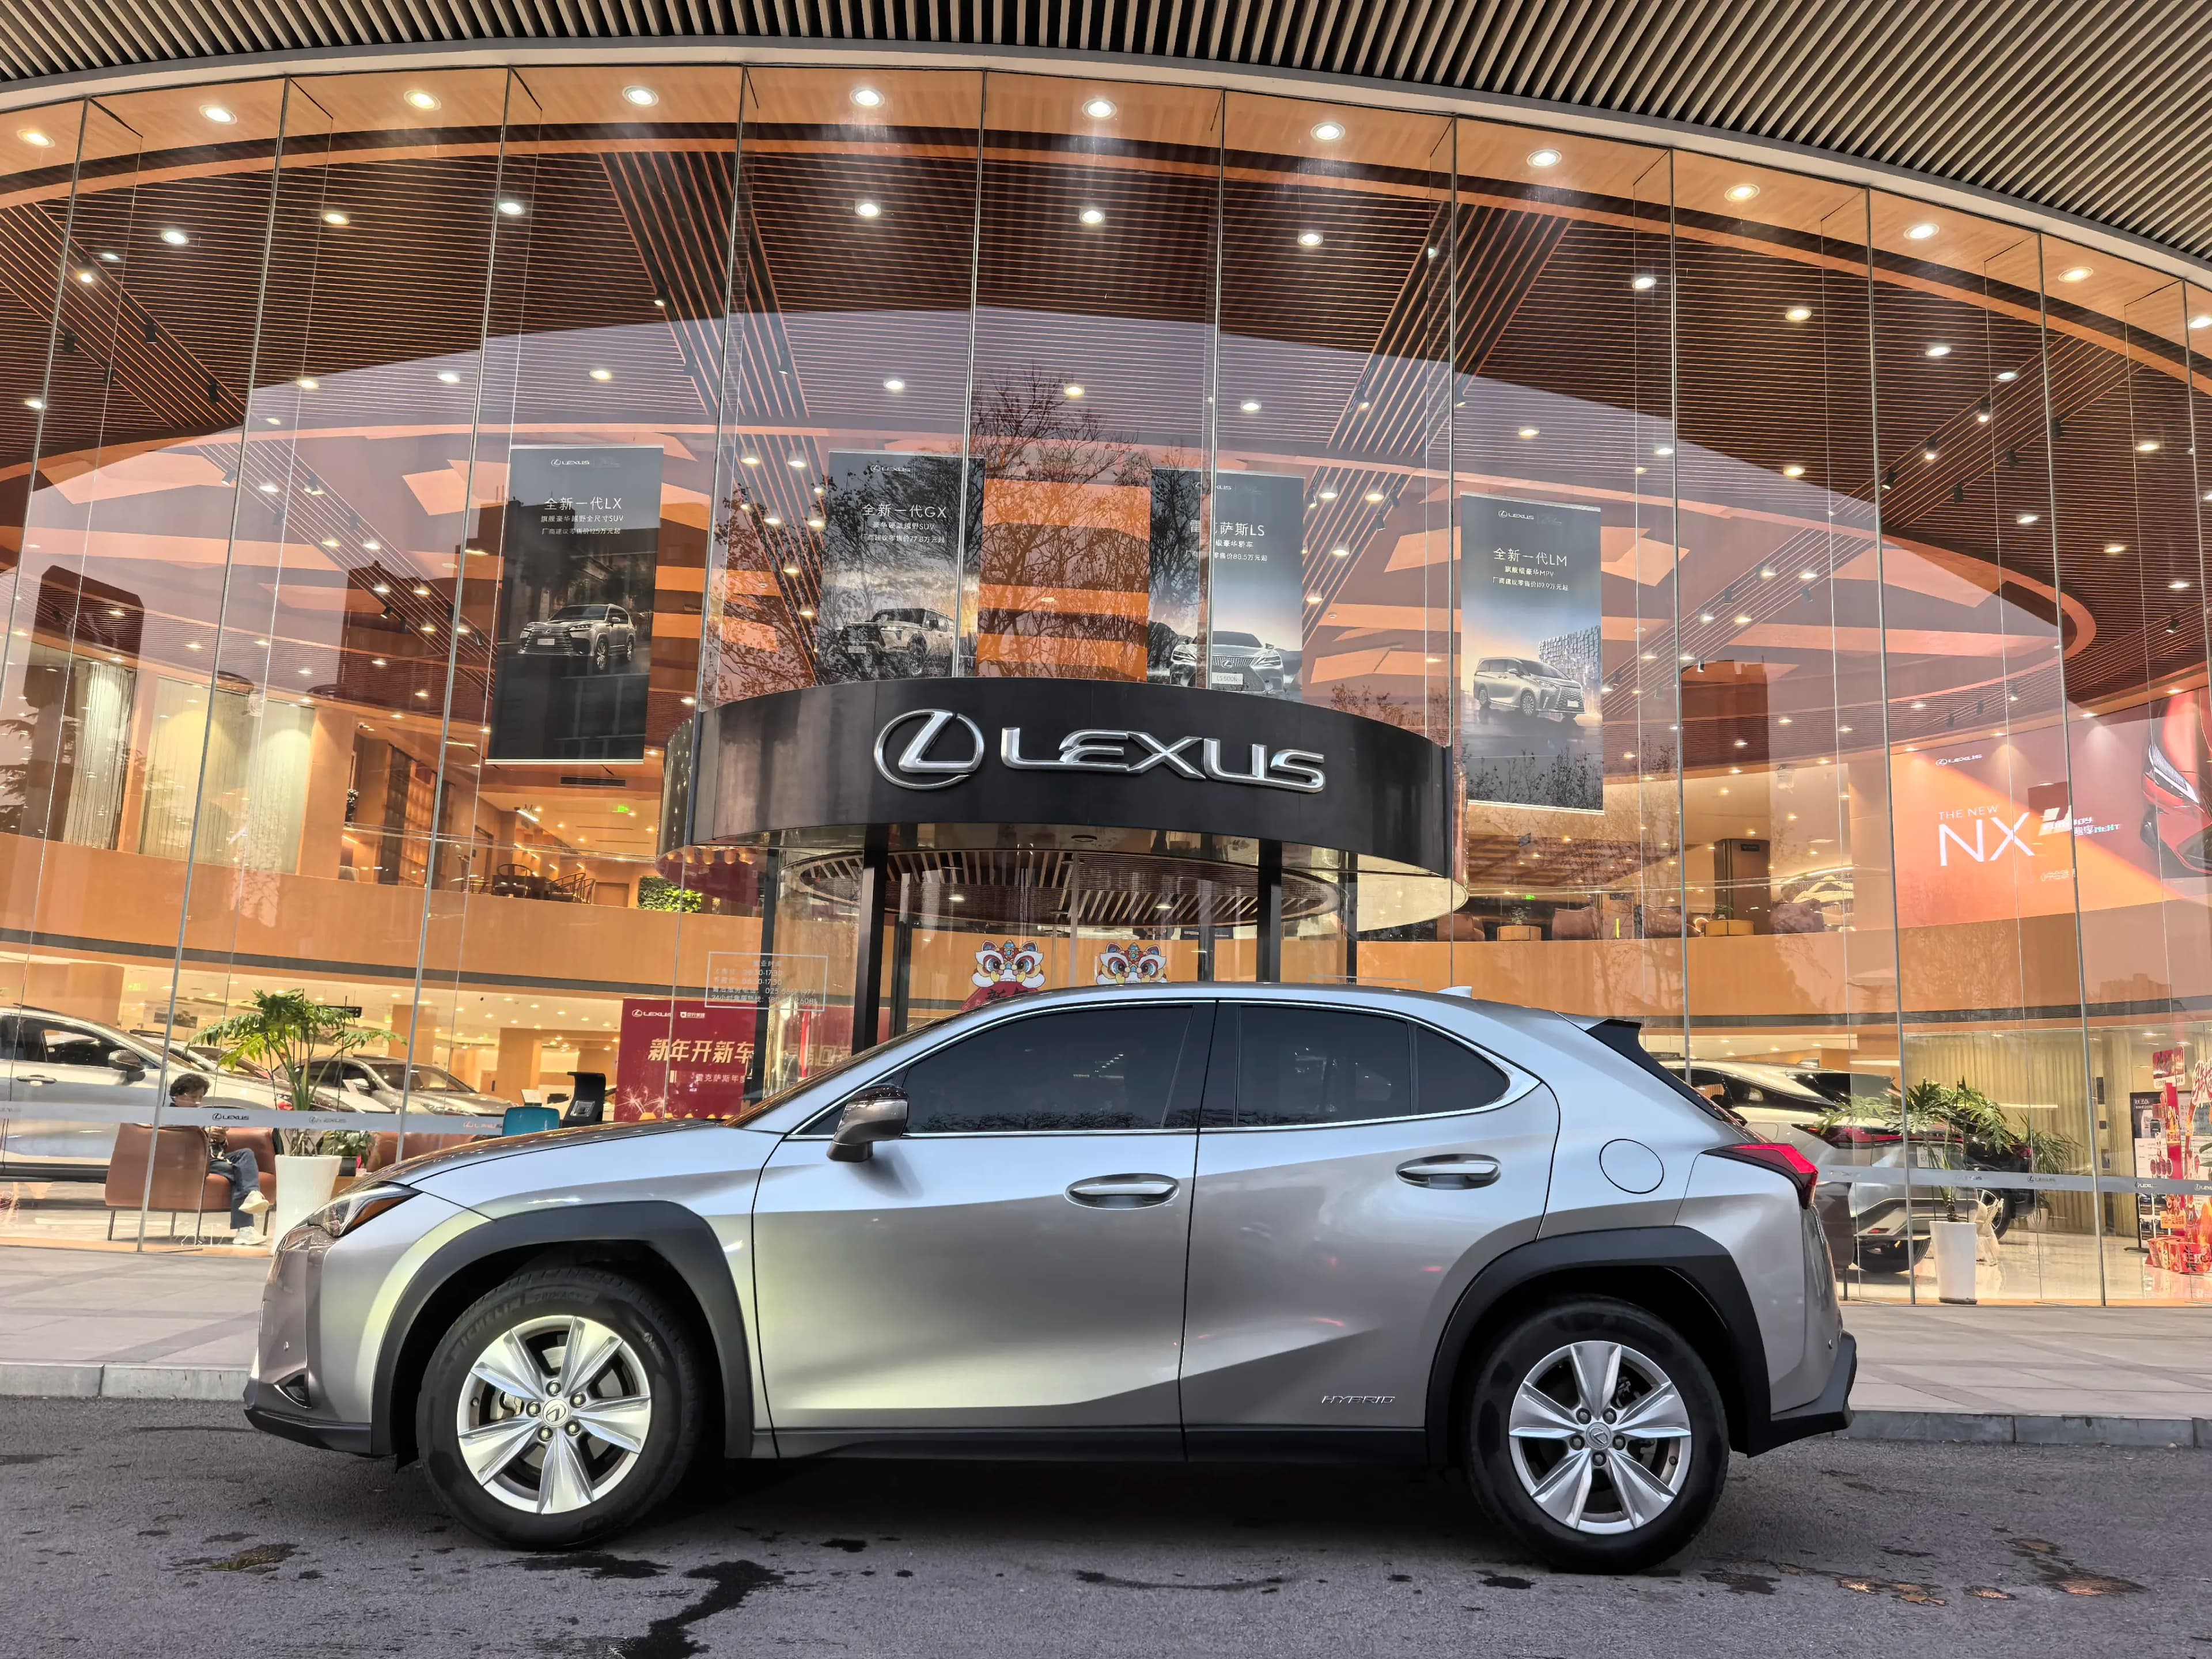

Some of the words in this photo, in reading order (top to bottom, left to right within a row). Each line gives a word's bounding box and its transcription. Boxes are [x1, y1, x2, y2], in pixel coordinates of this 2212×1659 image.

[544, 497, 622, 510] 全新一代LX
[862, 503, 947, 518] 全新一代GX
[1493, 547, 1567, 566] 全新一代LM
[1001, 727, 1325, 793] LEXUS
[1938, 809, 1963, 820] THE
[1968, 805, 1999, 816] NEW
[1938, 812, 2035, 866] NX
[648, 1037, 755, 1064] 新年开新车
[1321, 1396, 1395, 1404] HYBRID
